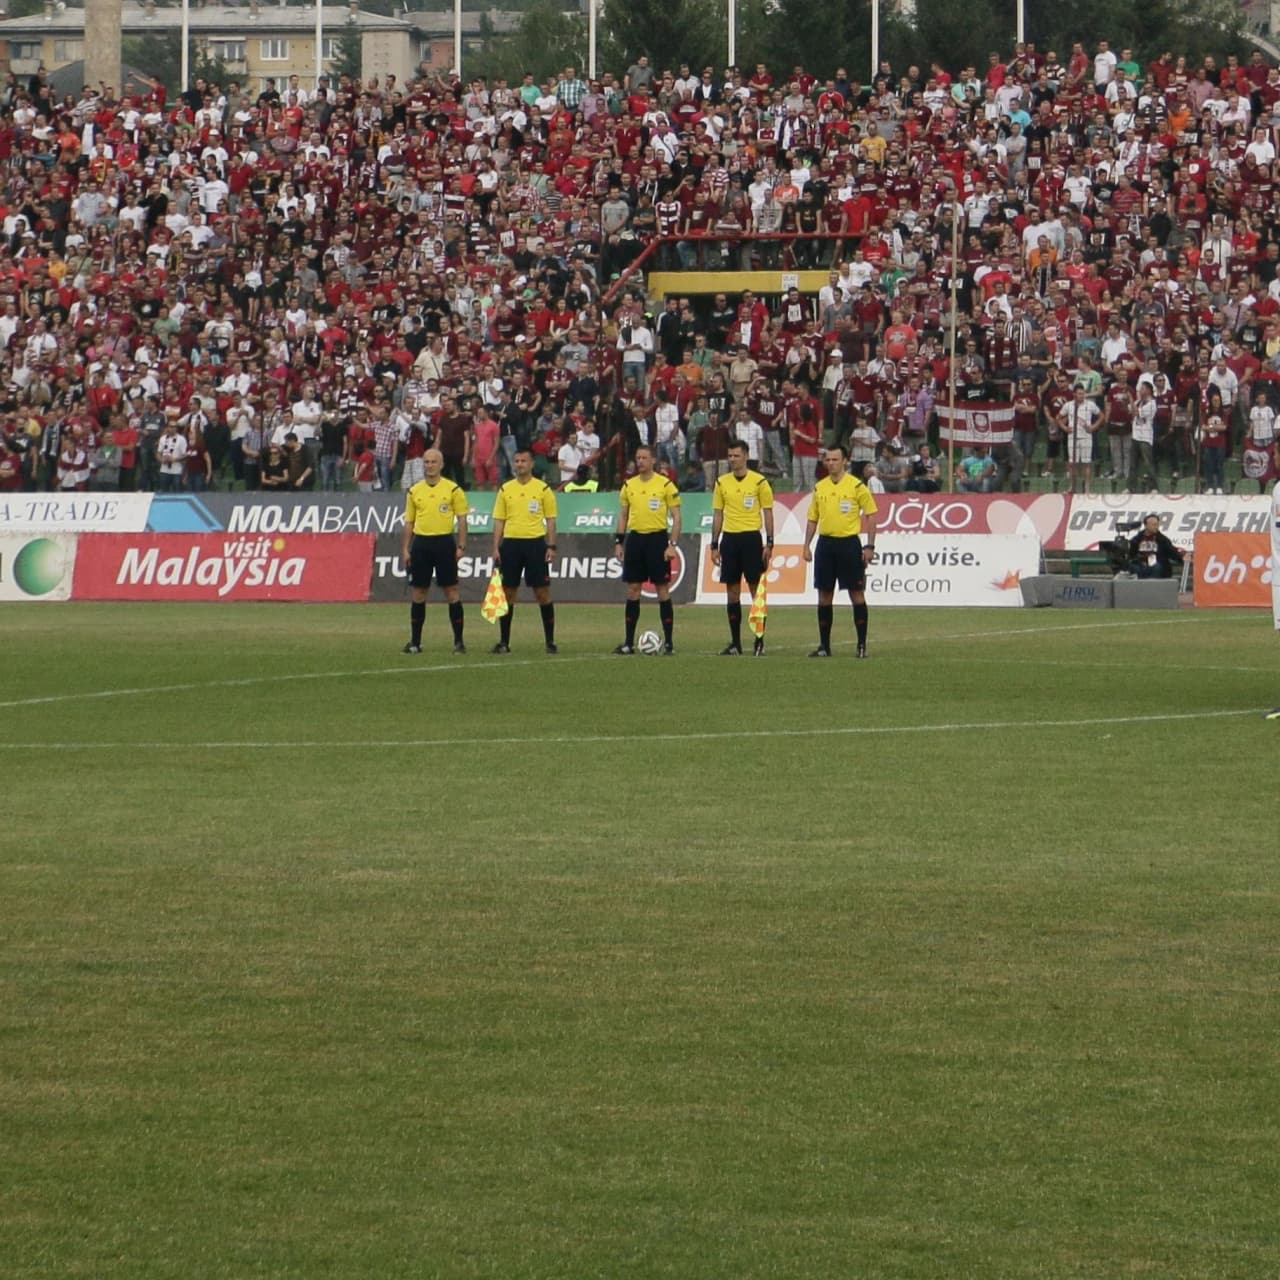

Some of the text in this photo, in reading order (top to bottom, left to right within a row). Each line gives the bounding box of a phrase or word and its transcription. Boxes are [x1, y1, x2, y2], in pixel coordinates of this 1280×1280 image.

[576, 513, 613, 526] PAN
[223, 536, 272, 558] visit
[926, 546, 980, 566] više.
[116, 547, 307, 596] Malaysia
[548, 557, 624, 578] LINES
[1203, 555, 1247, 584] bh
